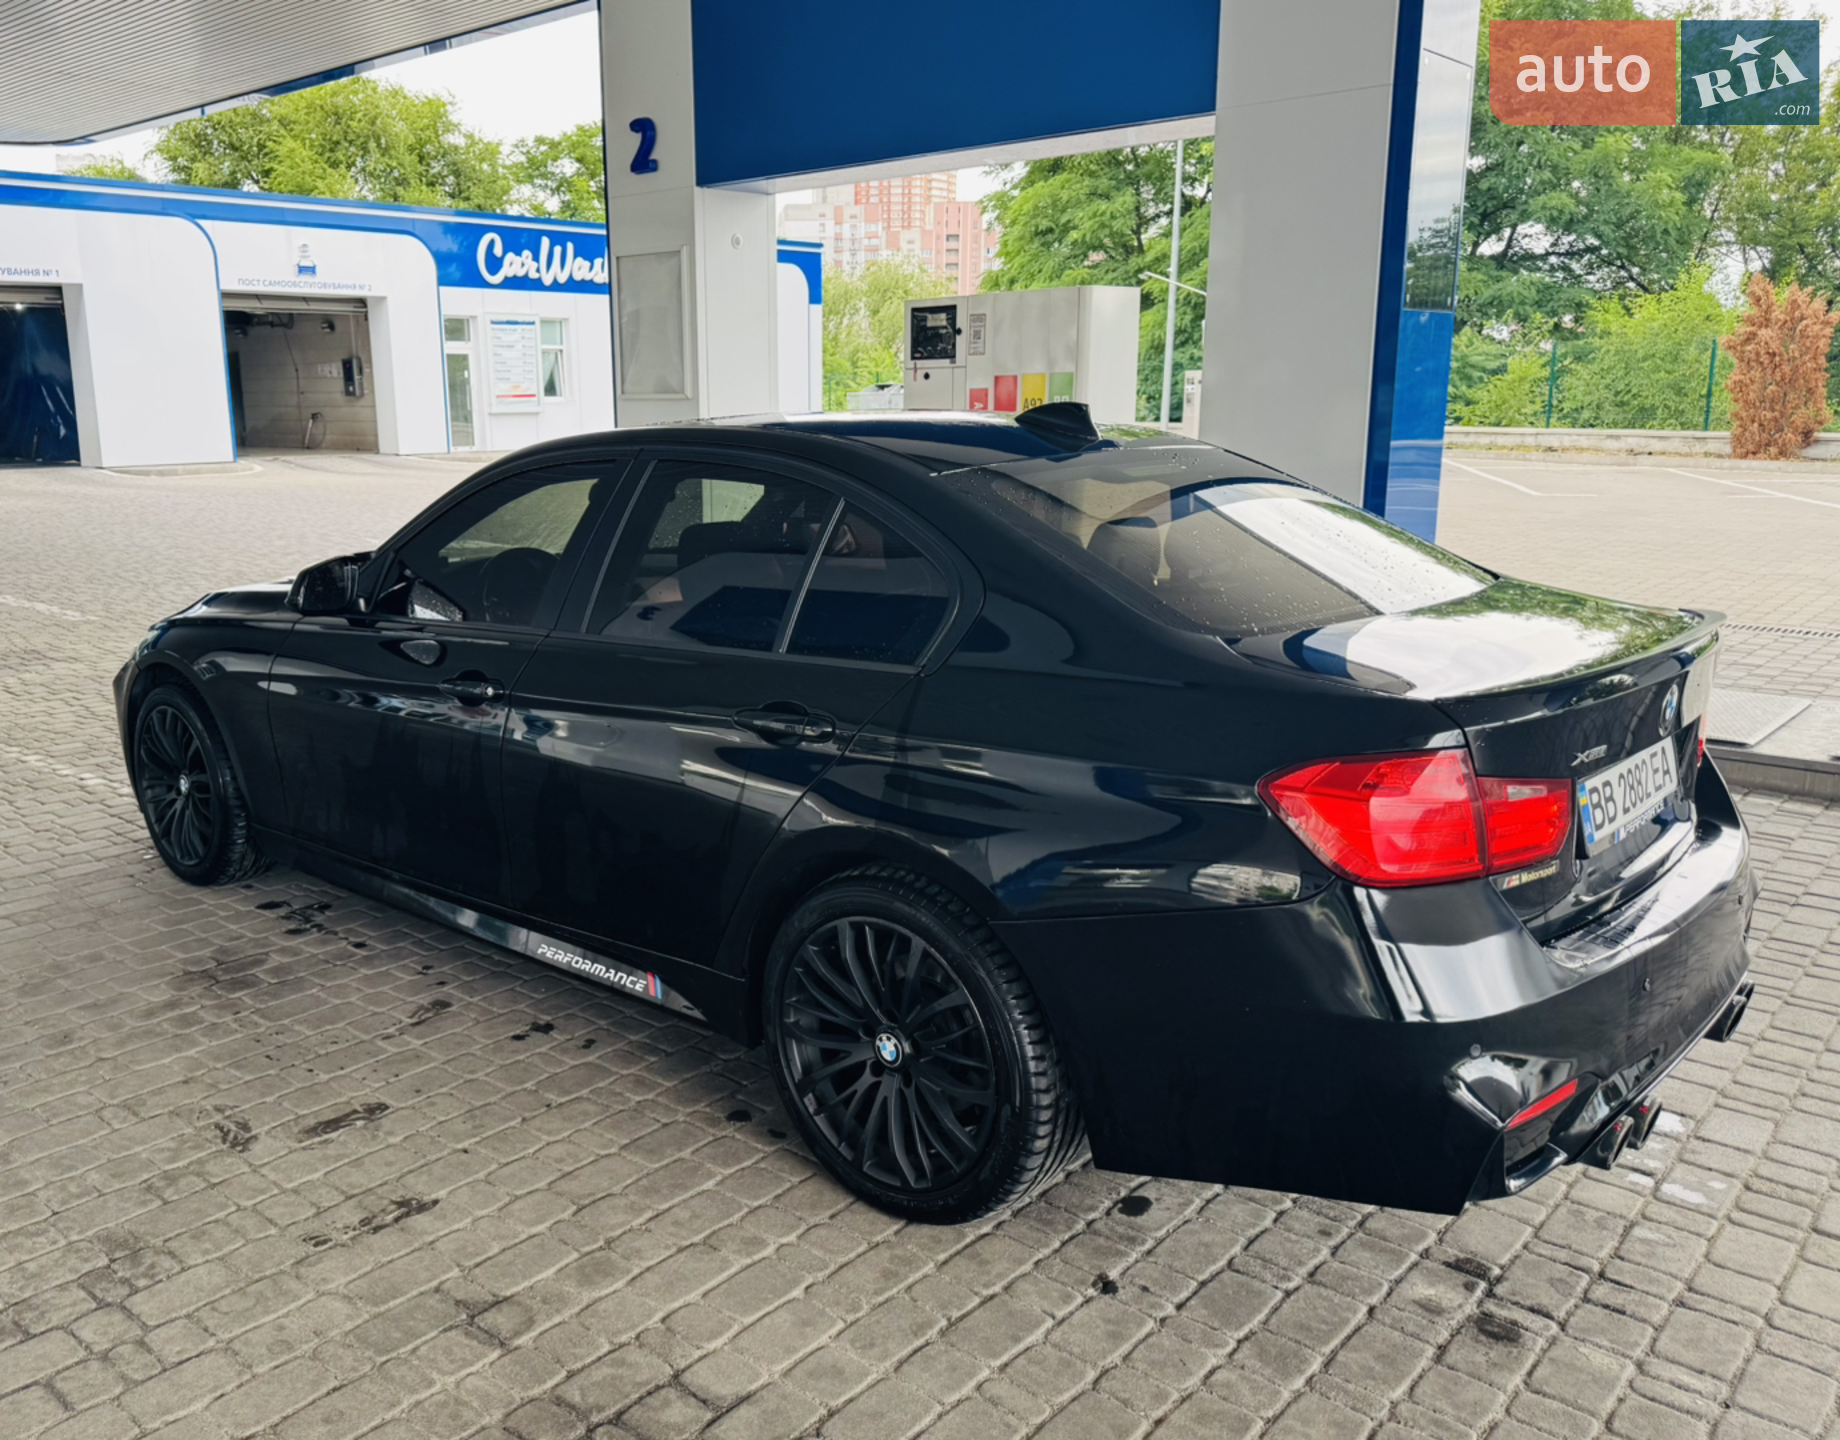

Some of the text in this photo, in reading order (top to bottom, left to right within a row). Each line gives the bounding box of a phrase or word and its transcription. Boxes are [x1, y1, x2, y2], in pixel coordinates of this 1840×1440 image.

[629, 116, 659, 175] 2
[237, 278, 260, 287] ПОСТ
[476, 232, 609, 287] CarWas
[1588, 745, 1673, 832] BB 2882 EA
[1520, 864, 1557, 885] Motorsport
[537, 943, 648, 993] PERFORMANCE
